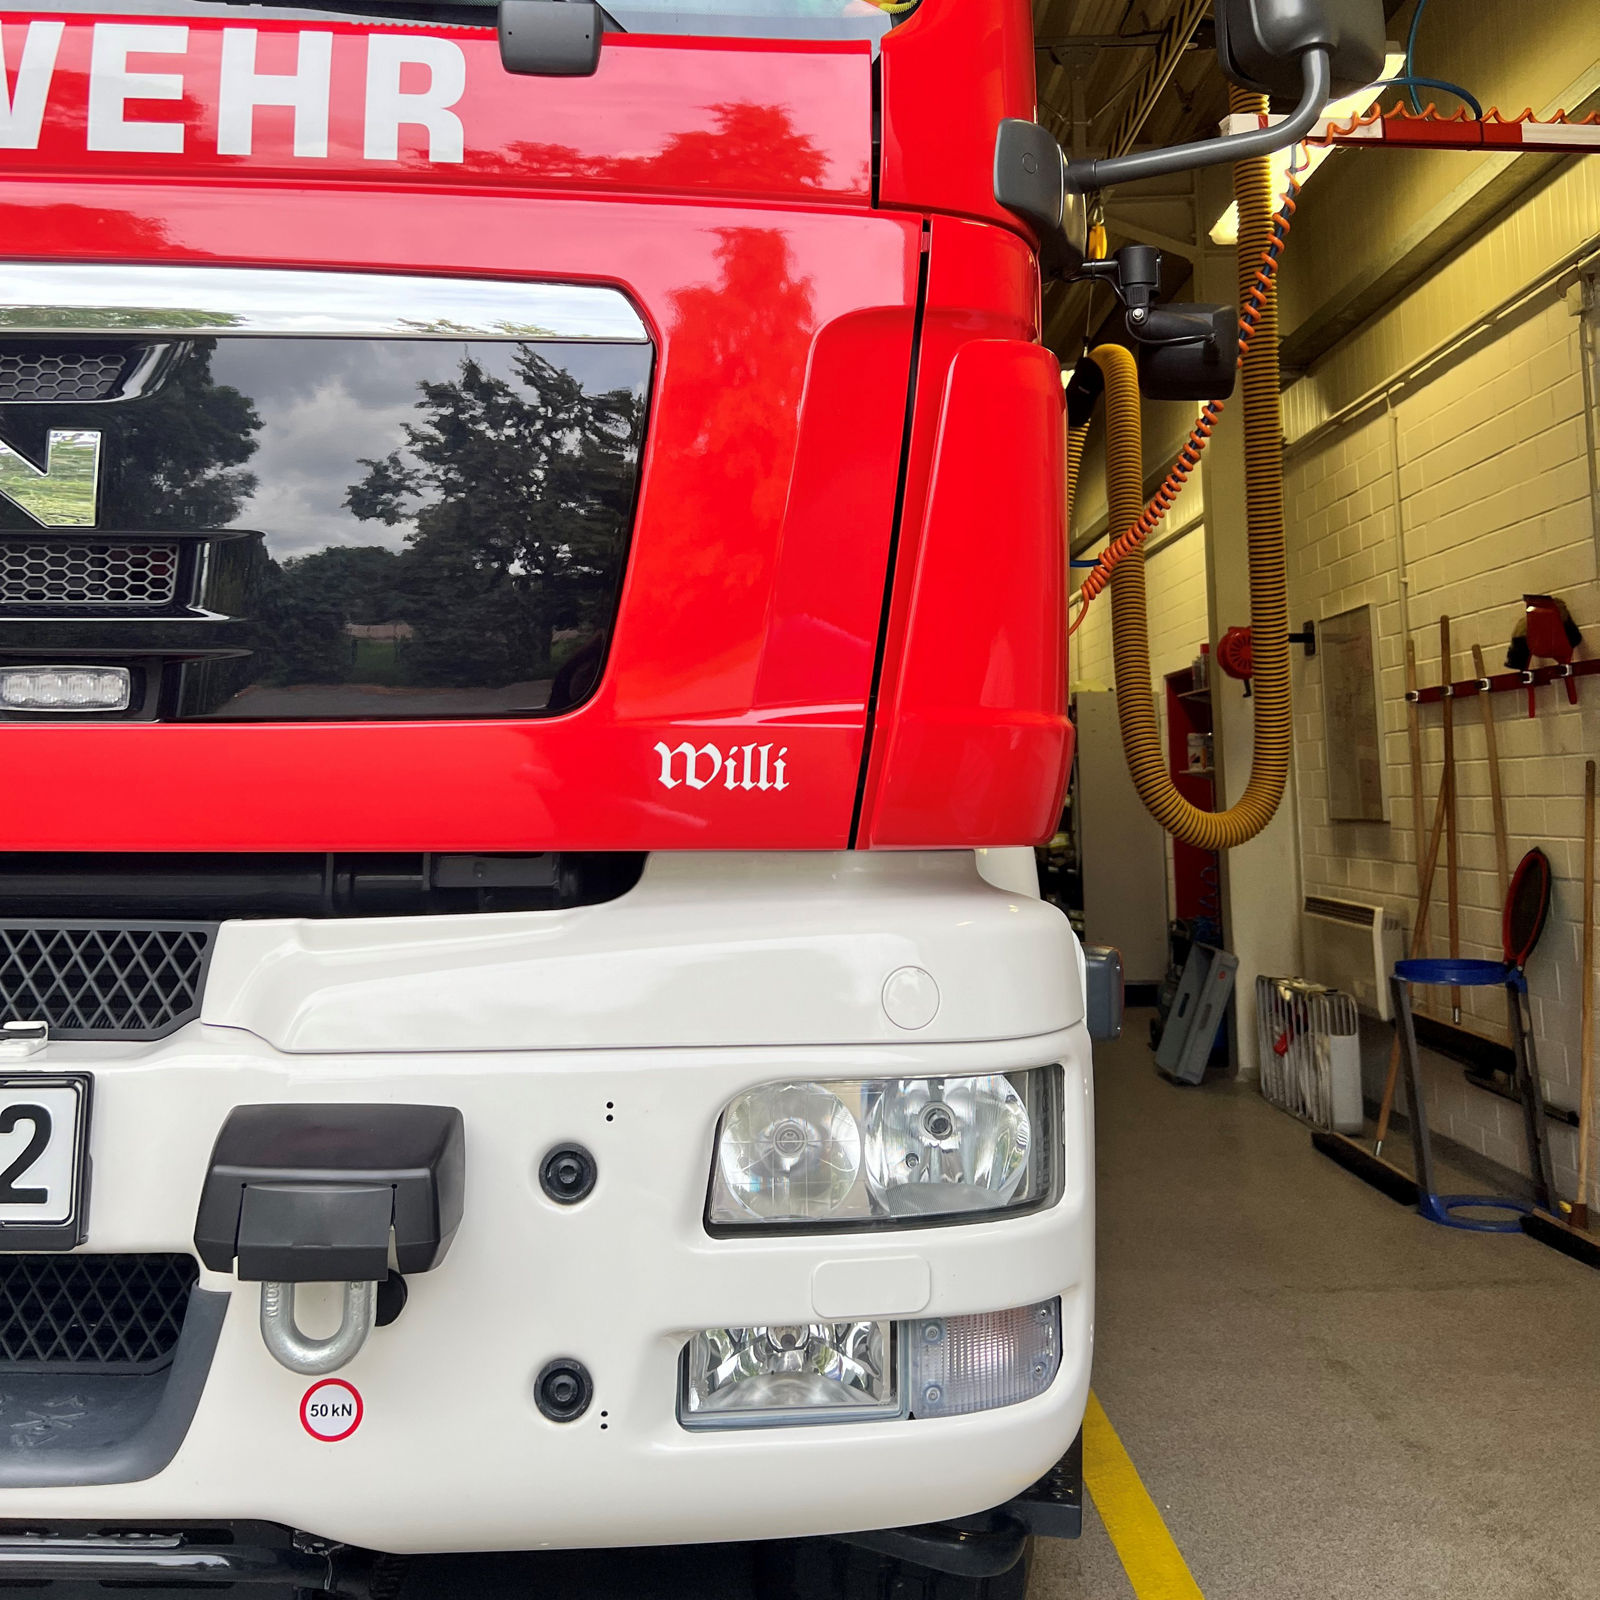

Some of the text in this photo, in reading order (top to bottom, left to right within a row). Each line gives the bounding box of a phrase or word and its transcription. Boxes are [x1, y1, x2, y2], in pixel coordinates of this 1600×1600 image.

[653, 741, 790, 792] Willi
[0, 1103, 52, 1204] 2
[310, 1403, 353, 1417] 50 kN
